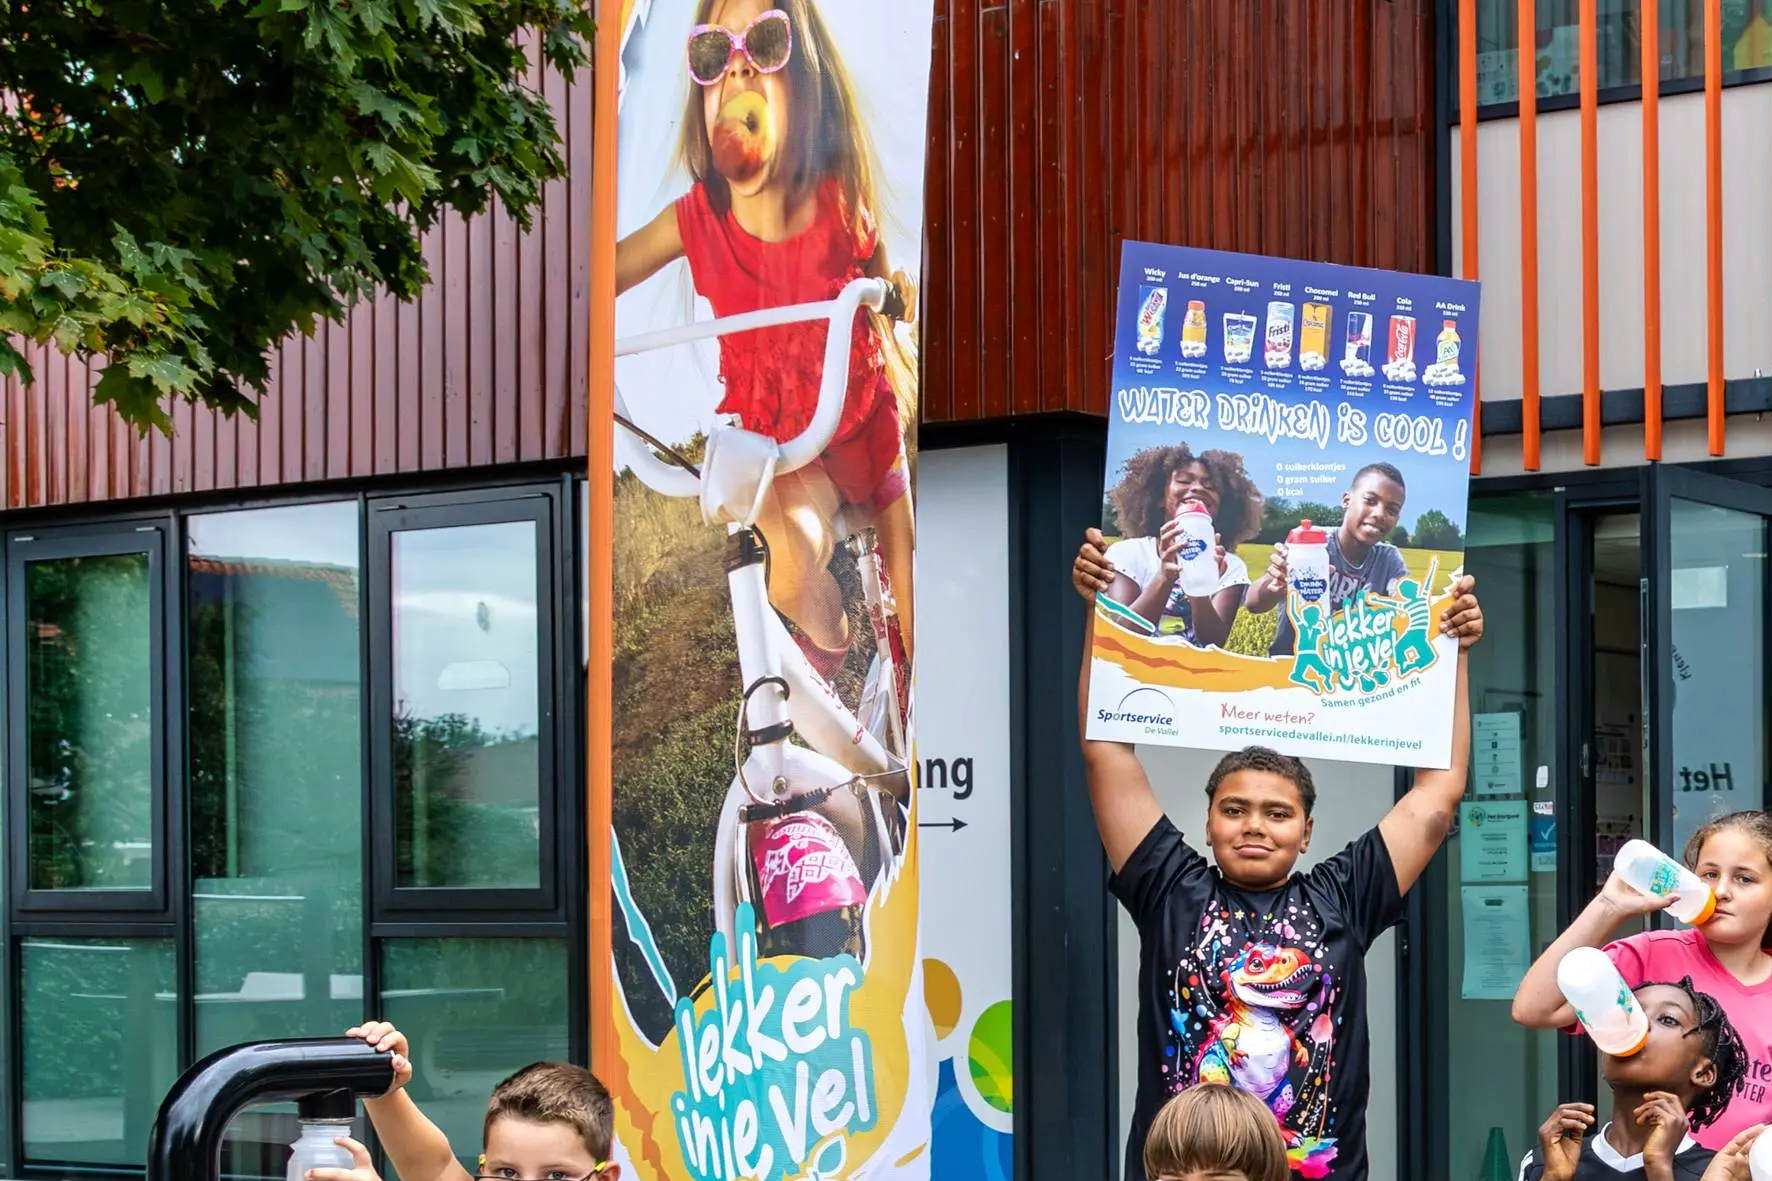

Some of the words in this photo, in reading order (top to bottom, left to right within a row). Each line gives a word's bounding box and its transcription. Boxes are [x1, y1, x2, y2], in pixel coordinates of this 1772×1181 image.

[1144, 267, 1166, 278] Wicky
[1178, 272, 1189, 280] Jus
[1191, 273, 1220, 284] d'orange
[1226, 277, 1259, 288] Capri-Sun
[1304, 286, 1338, 297] Chocomel
[1396, 297, 1412, 305] Cola
[1447, 303, 1466, 312] Drink
[1268, 322, 1290, 338] Fristi
[1118, 386, 1210, 430] WATER
[1374, 413, 1448, 455] COOL
[1285, 477, 1308, 485] gram
[1309, 475, 1336, 484] suiker
[1285, 487, 1303, 496] kcal
[1327, 598, 1395, 647] lekker
[1320, 696, 1356, 708] Samen
[1358, 690, 1395, 707] gezond
[1397, 684, 1409, 694] en
[1410, 677, 1421, 687] fit
[1097, 708, 1173, 726] Sportservice
[1221, 703, 1260, 720] Meer
[1264, 711, 1315, 725] weten?
[1145, 726, 1156, 734] De
[680, 931, 856, 1102] lekker
